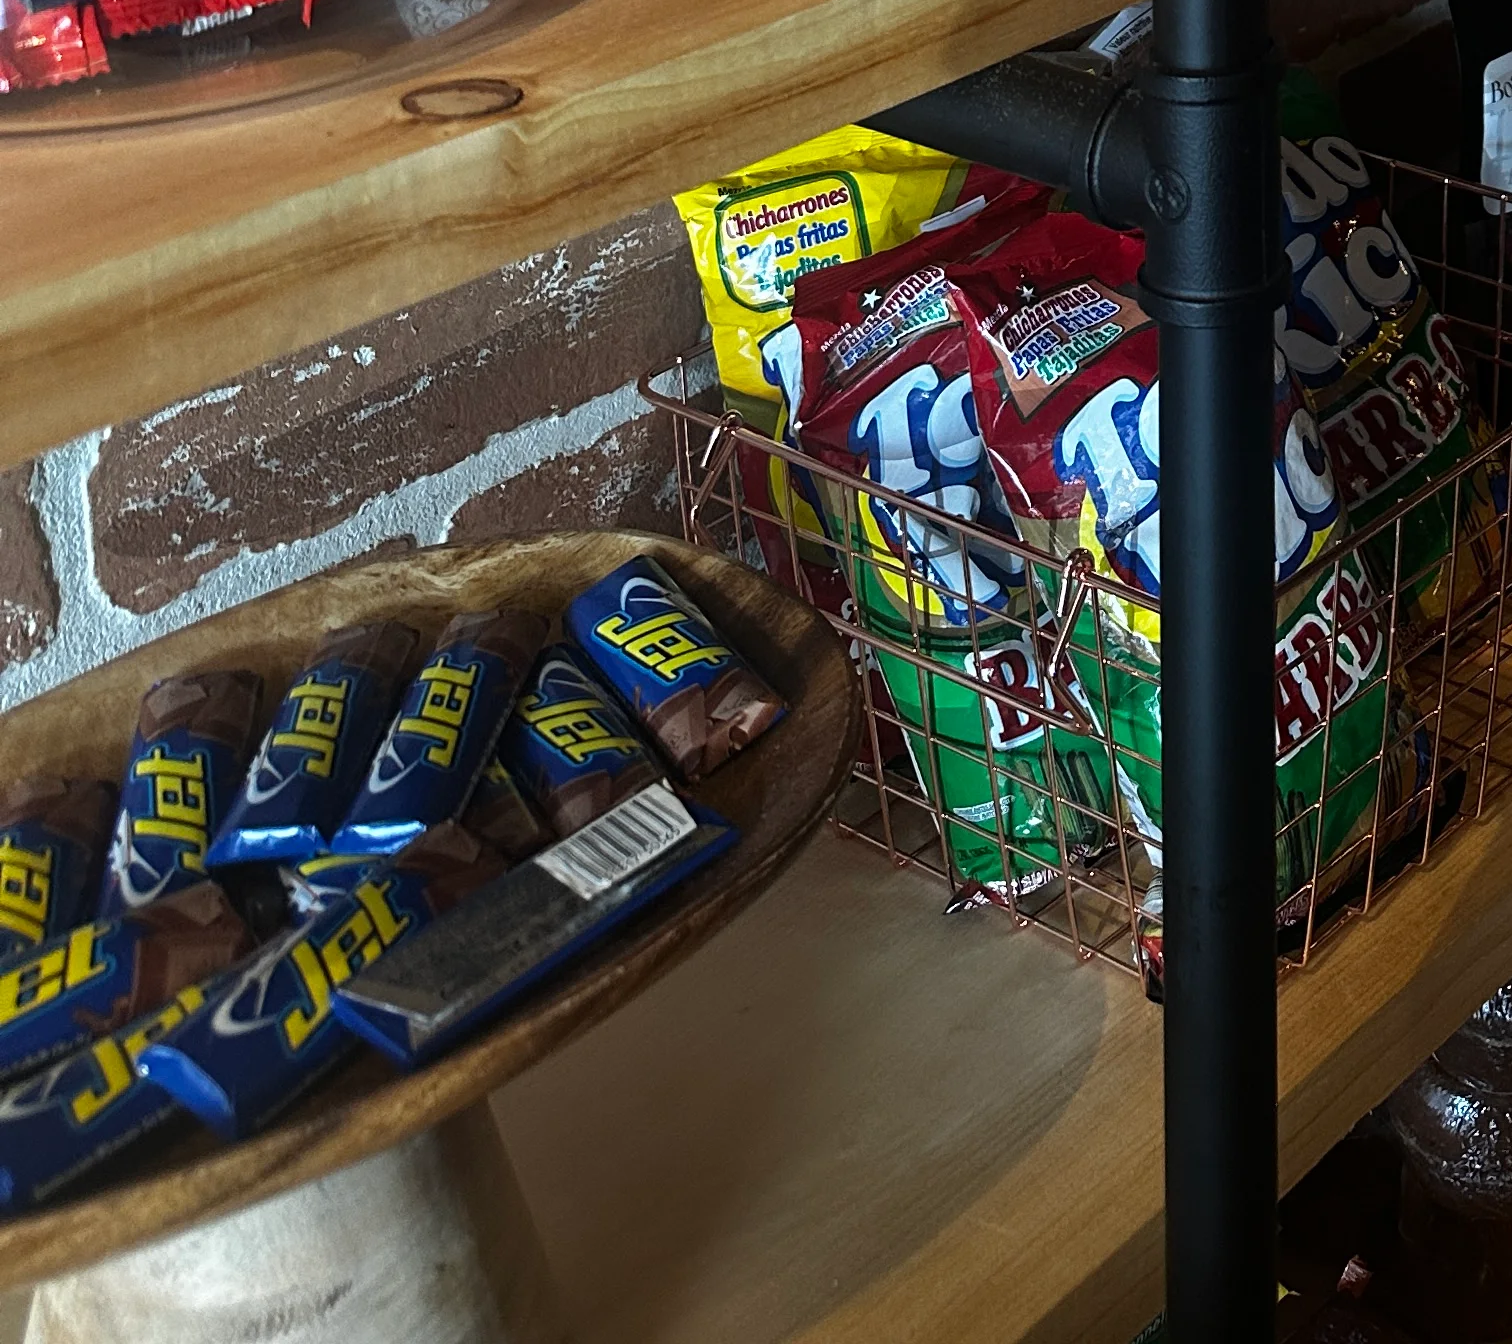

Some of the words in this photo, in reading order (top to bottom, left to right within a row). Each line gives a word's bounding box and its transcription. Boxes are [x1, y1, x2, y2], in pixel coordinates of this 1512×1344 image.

[727, 185, 848, 240] Chicharrones
[799, 220, 848, 252] fritas
[820, 321, 853, 353] Mezcla
[837, 265, 945, 353] Chicharrones
[981, 303, 1010, 333] Mezcla
[1001, 284, 1102, 353] Chicharrones
[1011, 330, 1060, 380] Papas
[1062, 301, 1121, 336] Fritas
[842, 323, 896, 370] Papas
[1037, 325, 1123, 385] Tajaditas
[597, 606, 729, 680] Jet
[271, 673, 348, 778] Jet
[400, 653, 481, 769] Jet
[521, 690, 639, 764] Jet
[134, 745, 211, 873] Jet
[284, 879, 410, 1052] Jet
